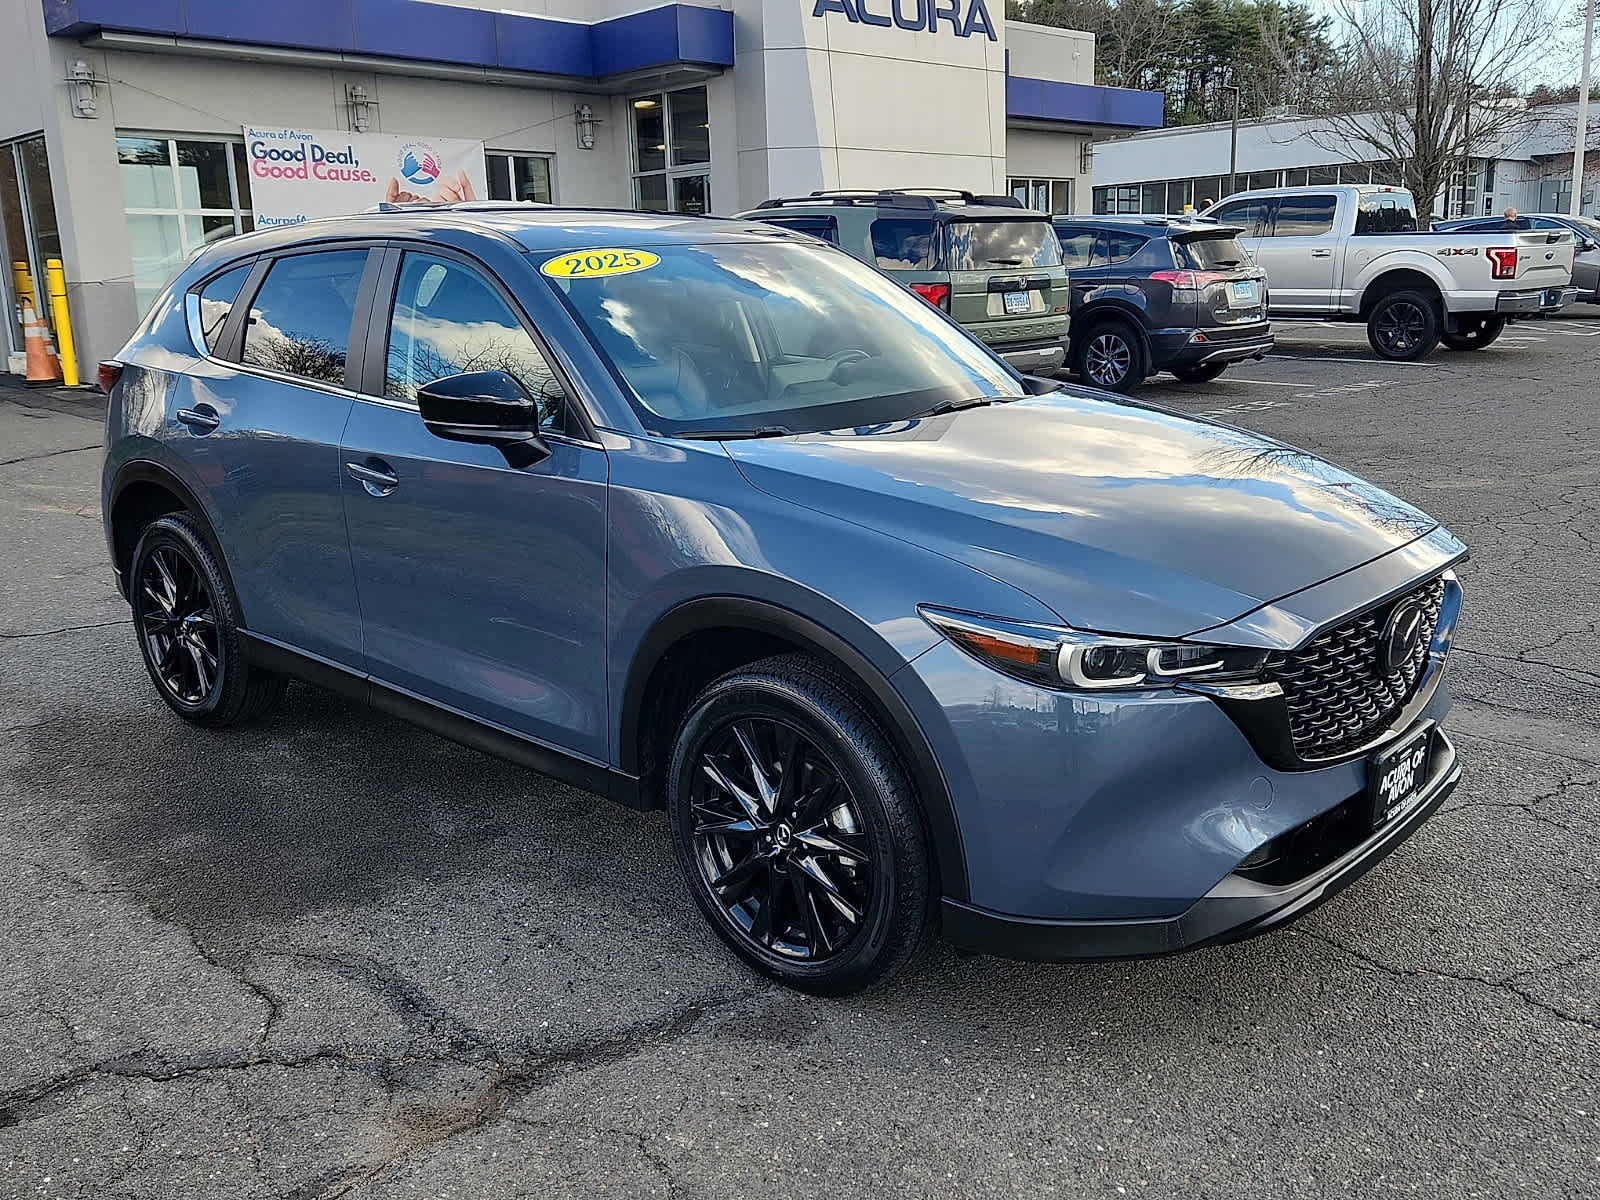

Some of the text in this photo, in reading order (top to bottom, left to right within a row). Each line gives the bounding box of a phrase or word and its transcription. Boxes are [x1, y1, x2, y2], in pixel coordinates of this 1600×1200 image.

[249, 128, 313, 141] Acura of Avon
[251, 141, 360, 168] Good Deal,
[253, 158, 377, 183] Good Cause.
[565, 252, 641, 275] 2025
[1379, 757, 1411, 795] ACURA
[1412, 746, 1426, 769] OF
[1387, 770, 1415, 805] AVON
